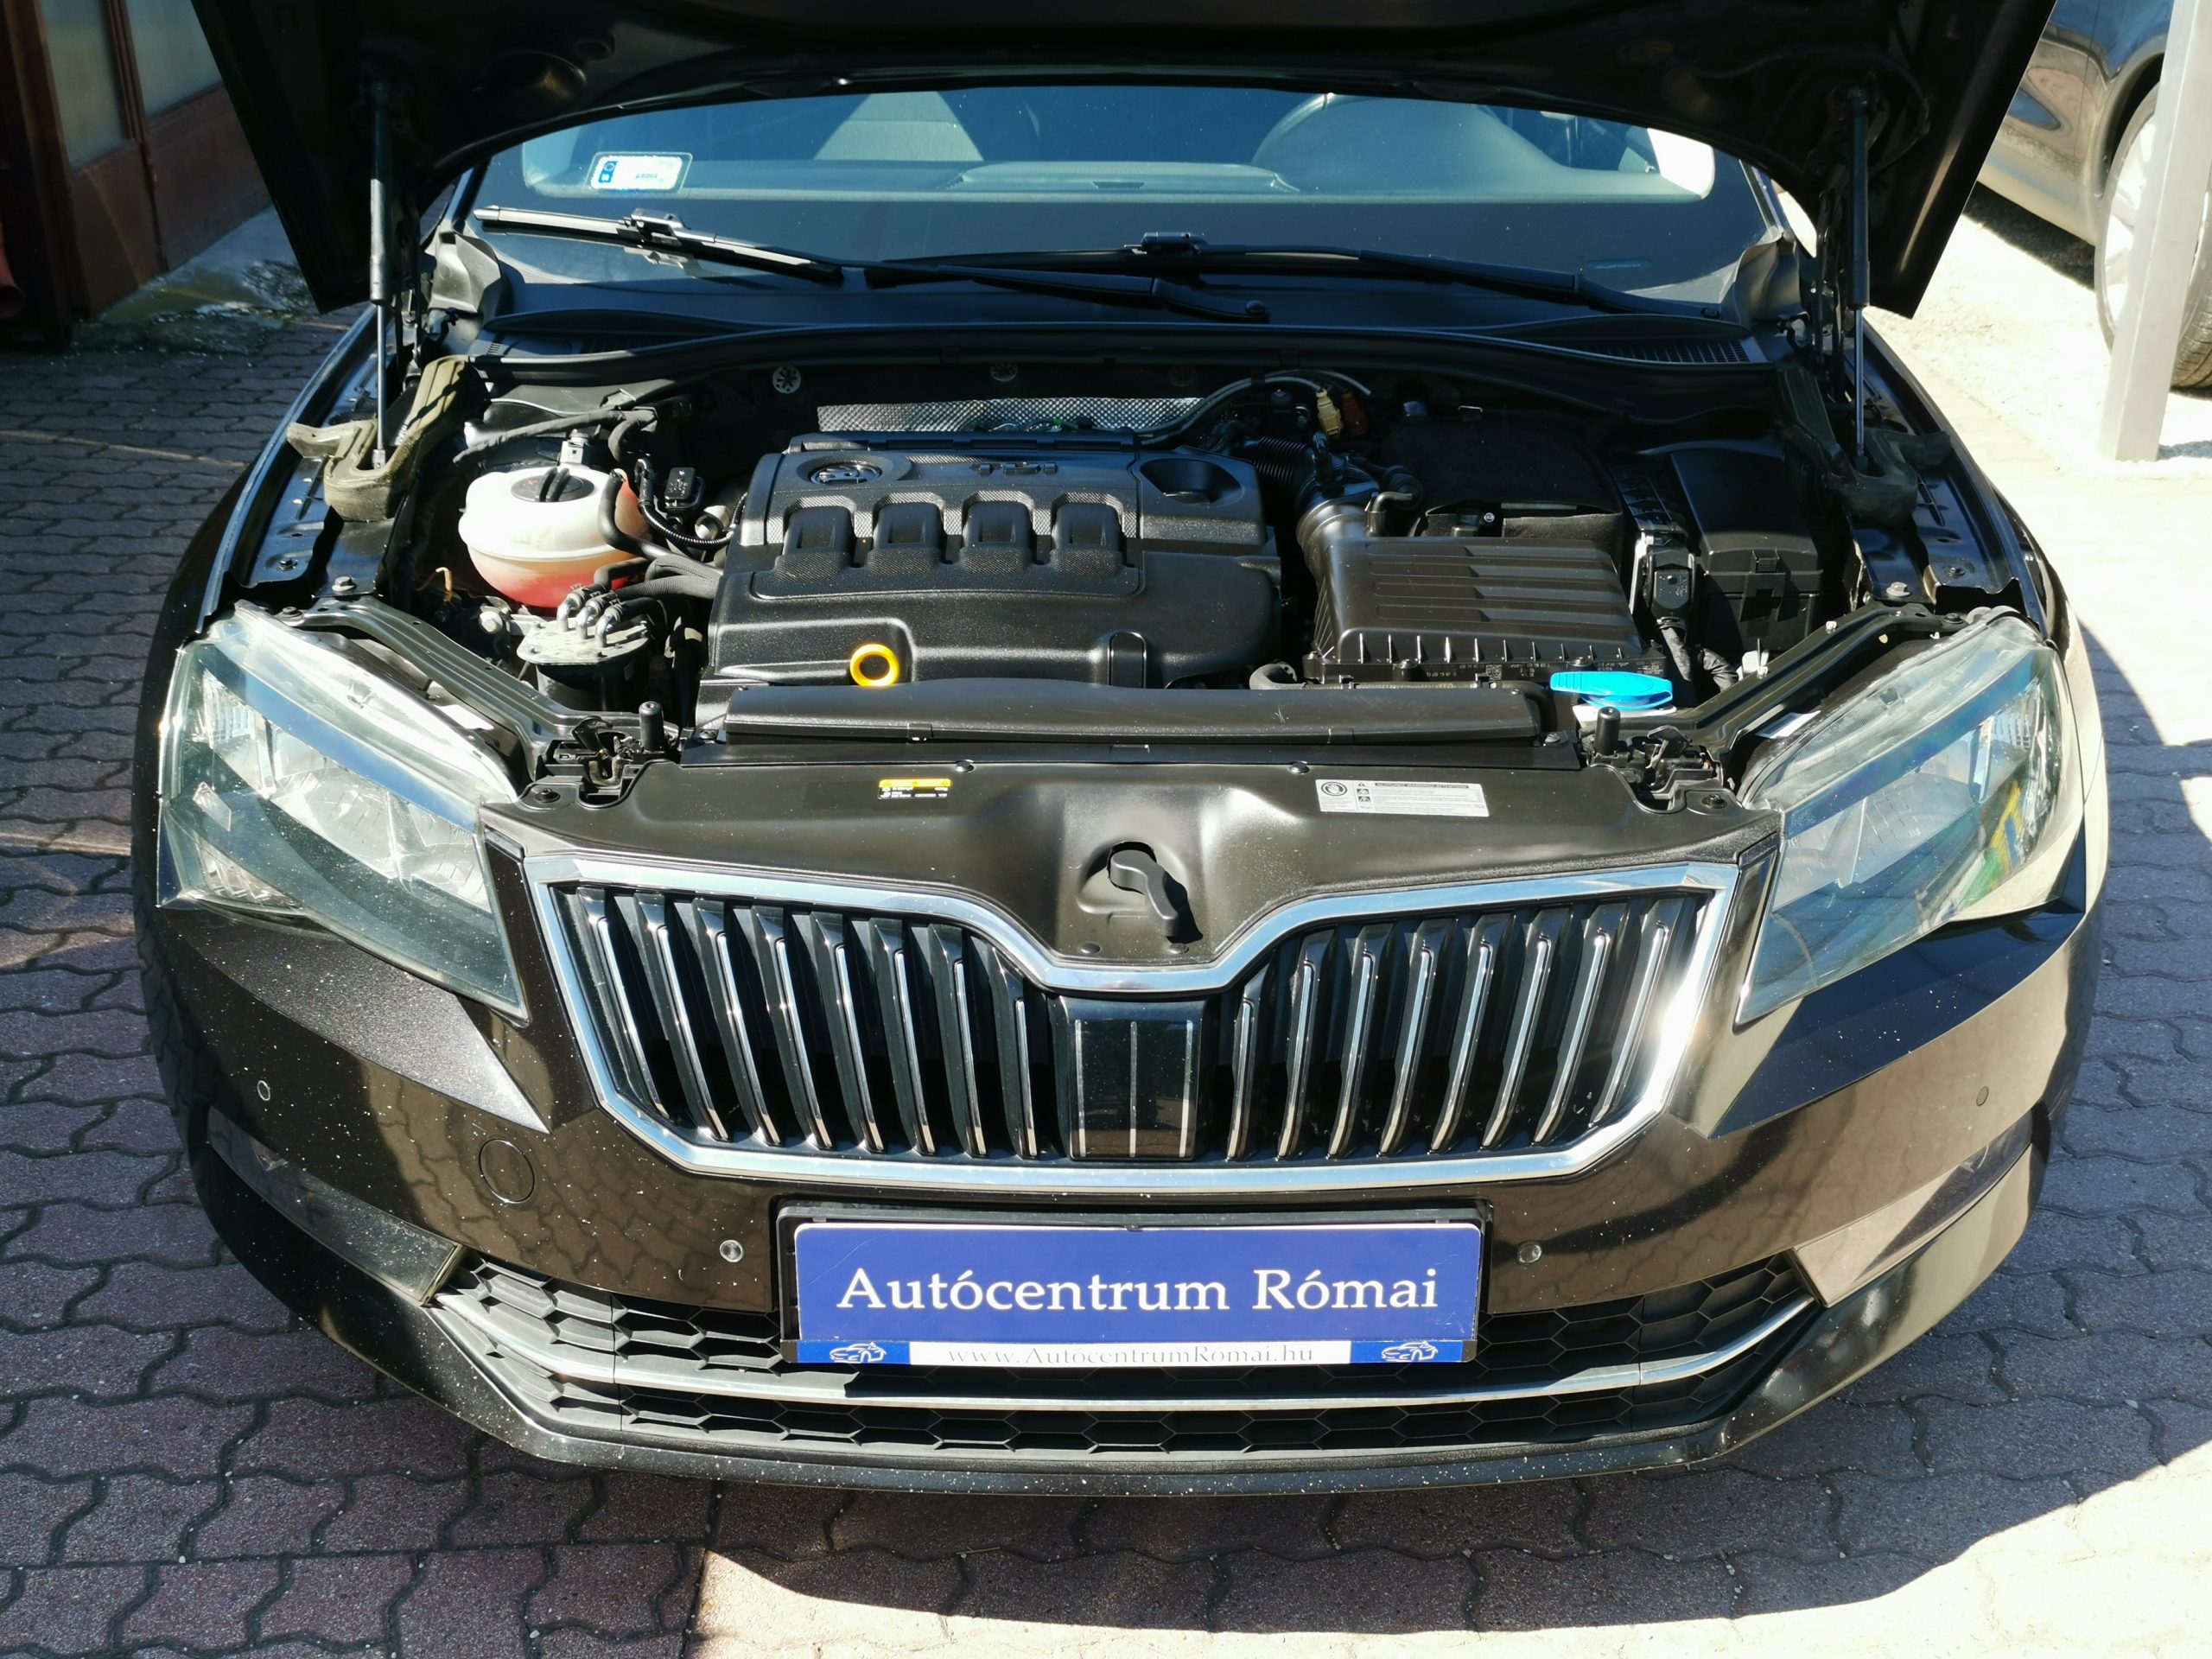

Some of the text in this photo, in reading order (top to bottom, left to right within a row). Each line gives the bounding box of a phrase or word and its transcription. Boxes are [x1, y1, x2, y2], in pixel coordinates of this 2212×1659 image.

[836, 1268, 1439, 1311] Autócentrum Római
[948, 1344, 1313, 1365] www.AutócentrumRómai.hu
